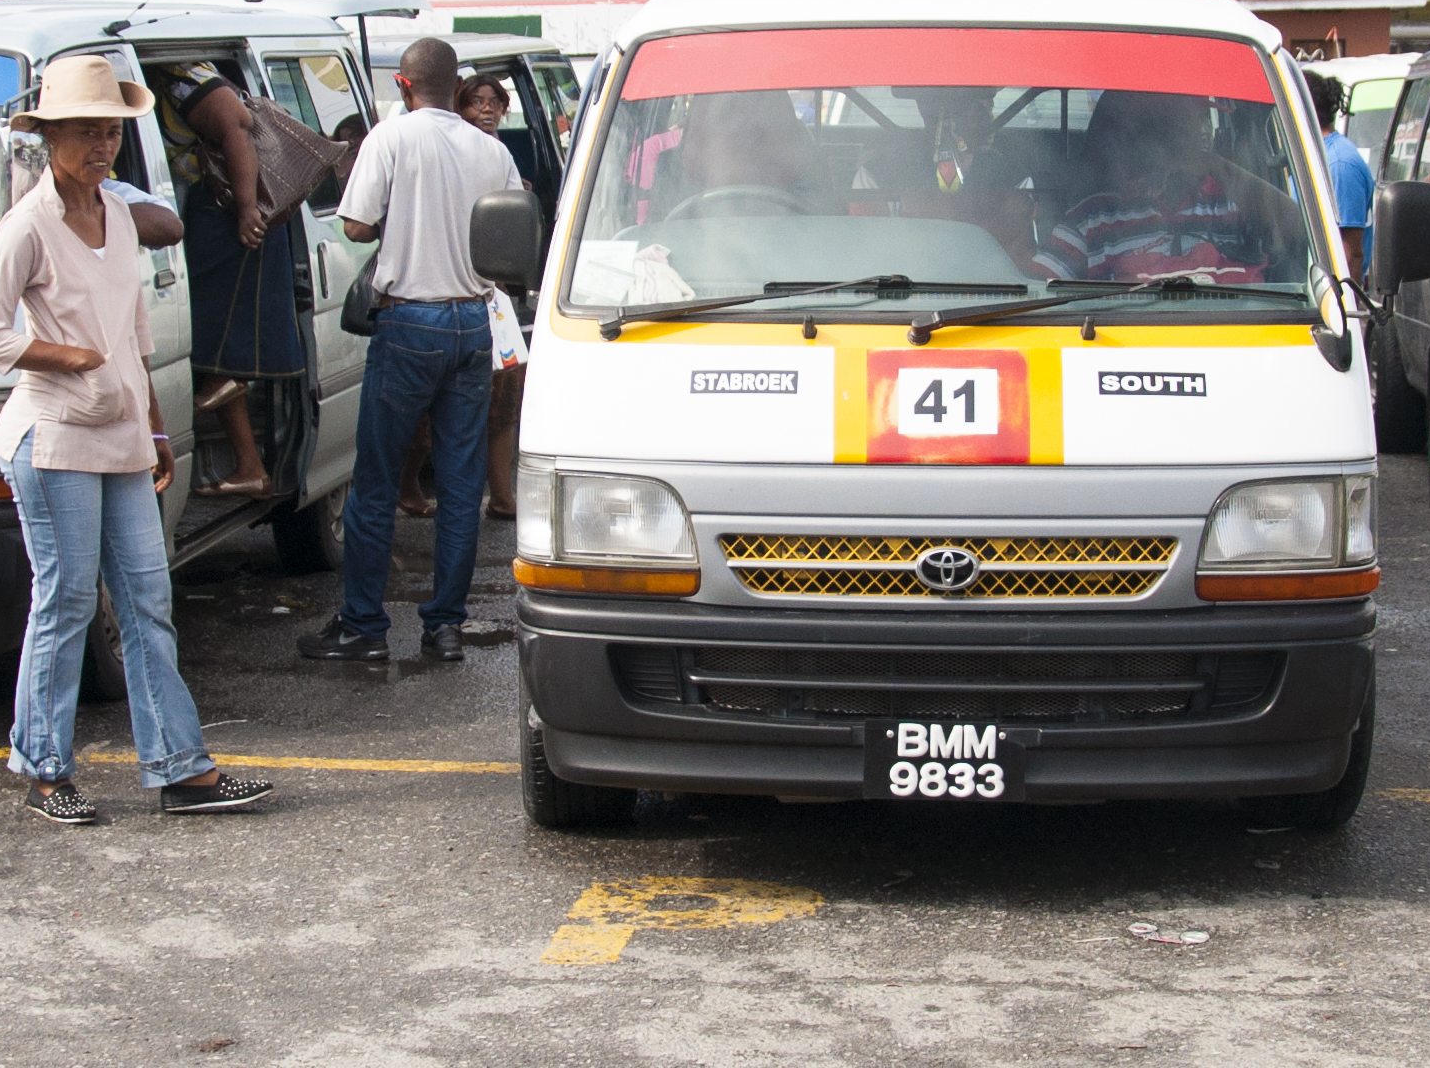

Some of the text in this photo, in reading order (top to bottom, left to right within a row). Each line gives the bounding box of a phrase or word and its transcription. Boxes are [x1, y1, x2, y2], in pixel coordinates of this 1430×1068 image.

[693, 372, 796, 391] STABROEK
[1101, 374, 1205, 393] SOUTH
[914, 379, 975, 423] 41
[897, 722, 997, 759] BMM
[889, 761, 1005, 798] 9833
